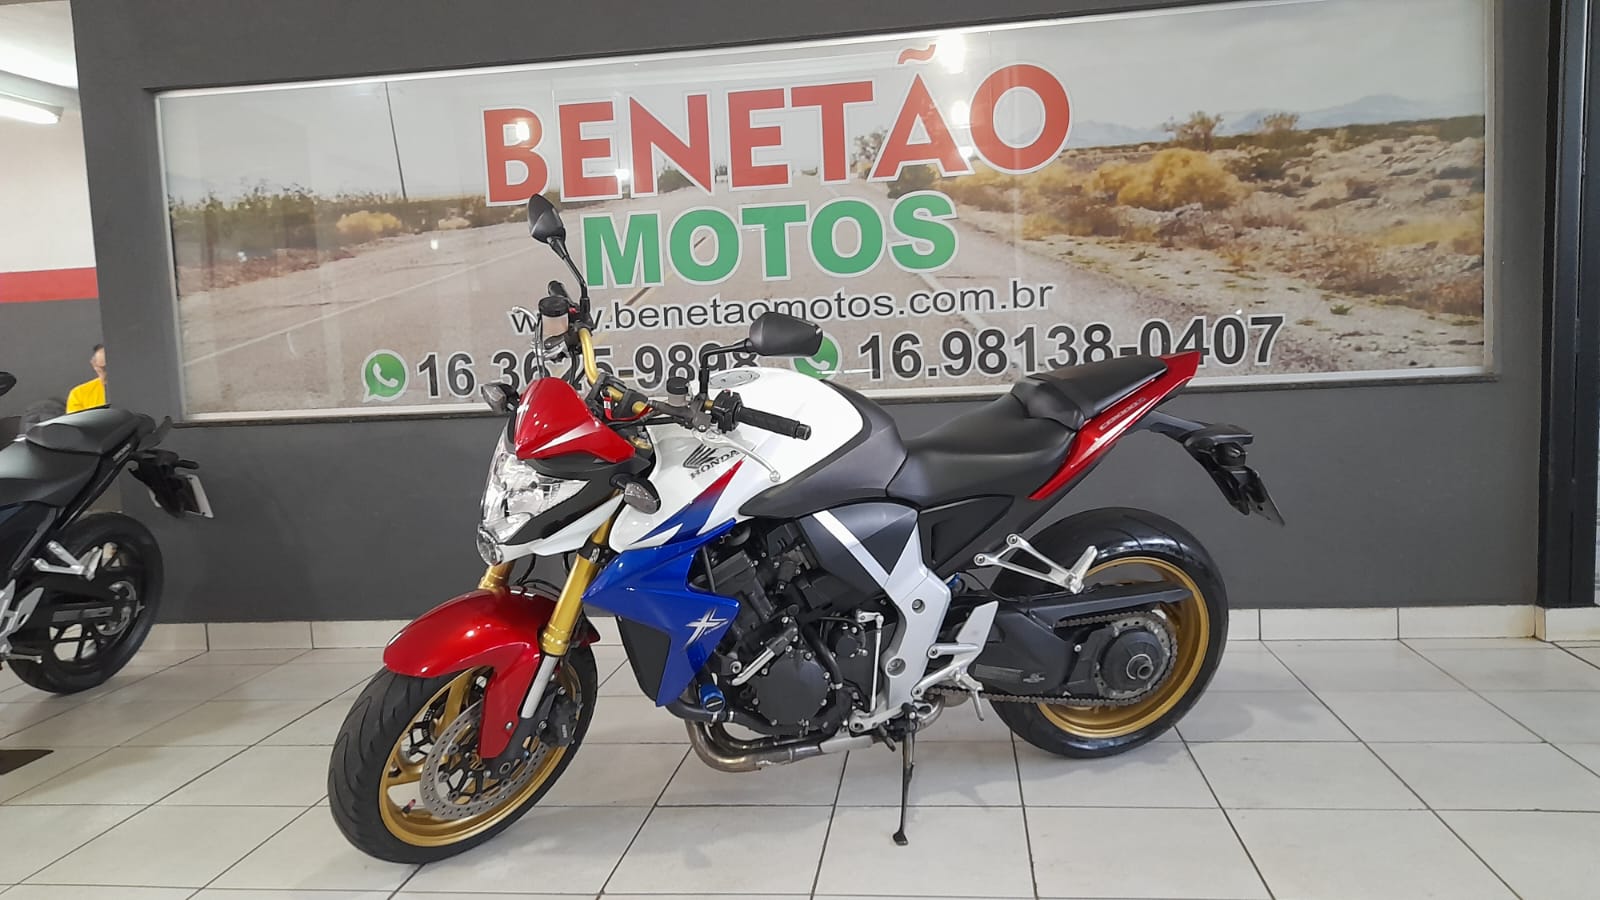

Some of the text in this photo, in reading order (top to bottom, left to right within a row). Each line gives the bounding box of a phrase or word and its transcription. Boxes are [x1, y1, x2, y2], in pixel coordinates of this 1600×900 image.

[483, 43, 1071, 203] BENETÃO
[583, 194, 957, 287] MOTOS
[511, 281, 1054, 332] w.benetaomotos.com.br
[860, 315, 1284, 380] 16.98138-0407
[689, 449, 741, 480] HONDA
